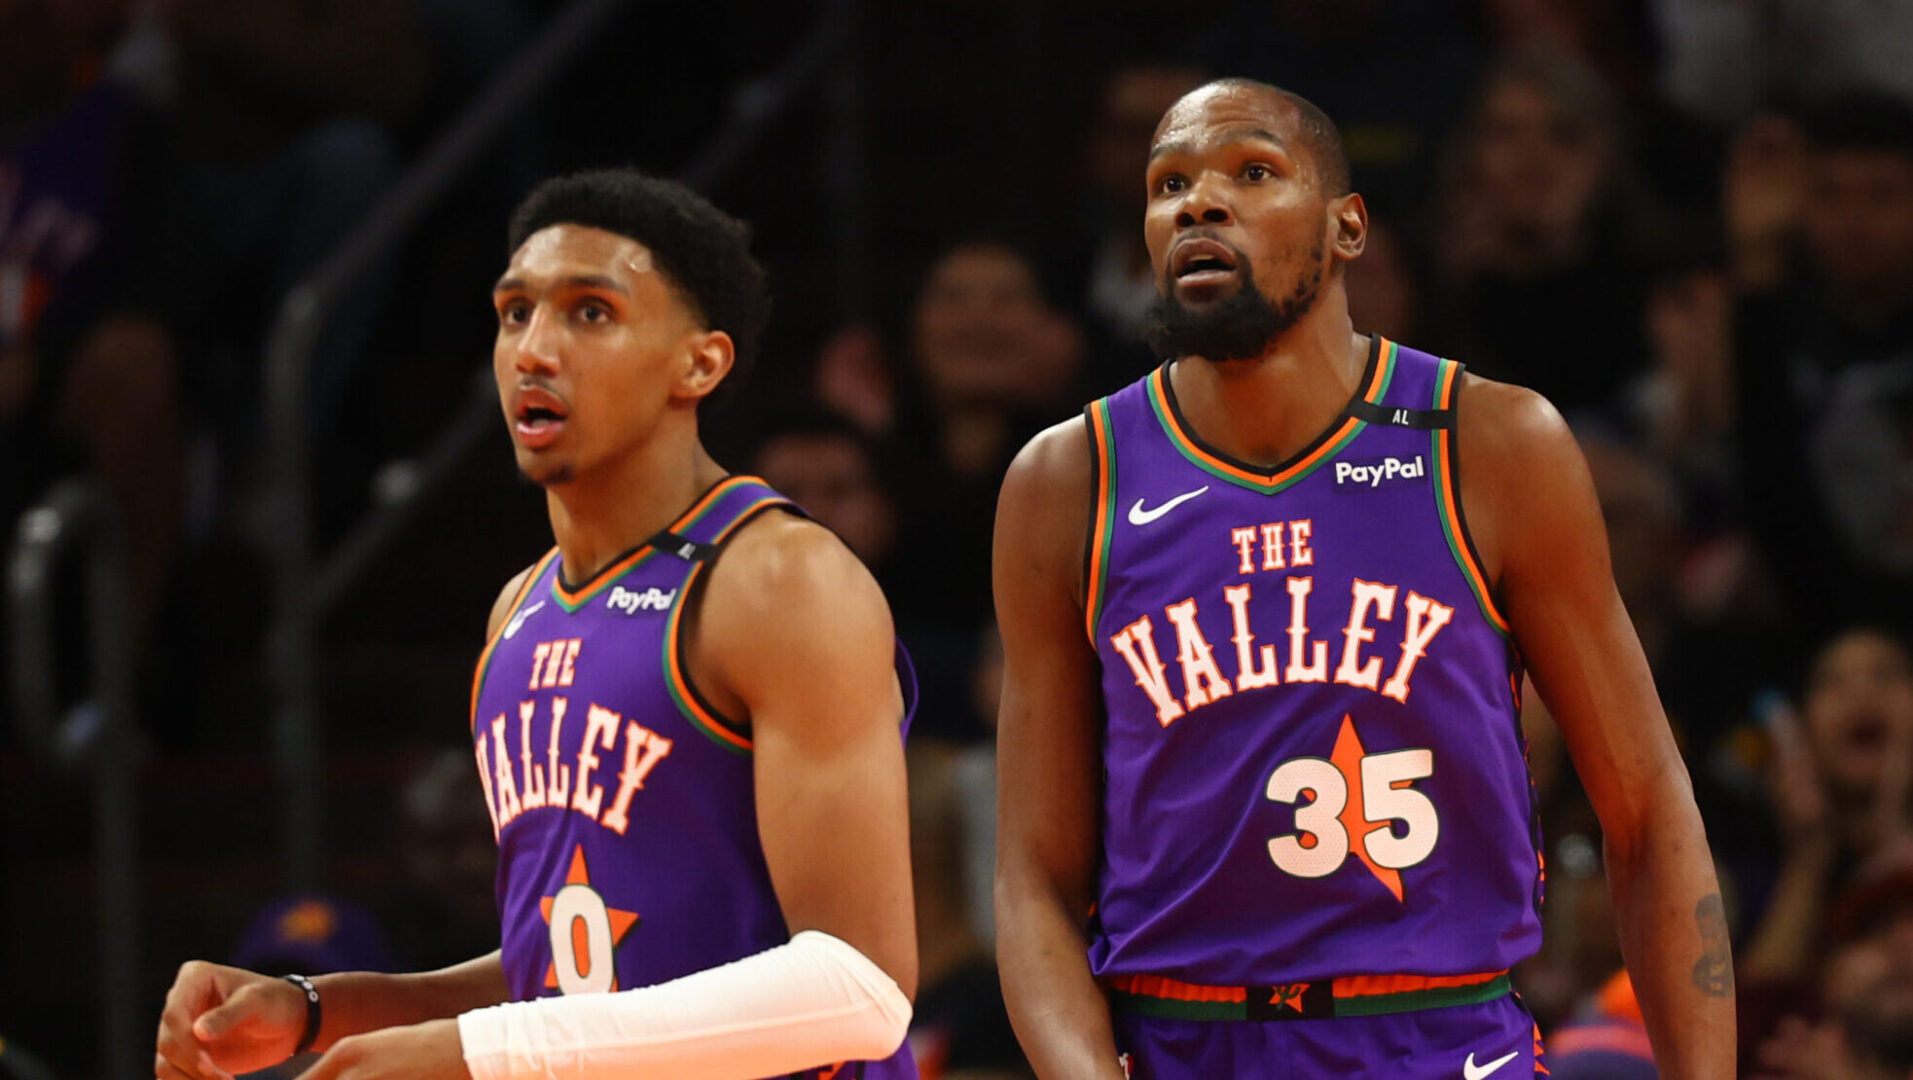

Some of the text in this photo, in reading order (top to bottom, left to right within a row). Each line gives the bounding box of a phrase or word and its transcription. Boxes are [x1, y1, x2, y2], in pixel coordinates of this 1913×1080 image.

[1392, 409, 1410, 426] AL
[1336, 455, 1425, 487] PayPal
[1232, 519, 1314, 575] THE
[606, 587, 677, 615] PayPal
[529, 637, 583, 691] THE
[1111, 576, 1455, 728] VALLEY
[1265, 748, 1440, 880] 35
[548, 882, 617, 996] 0
